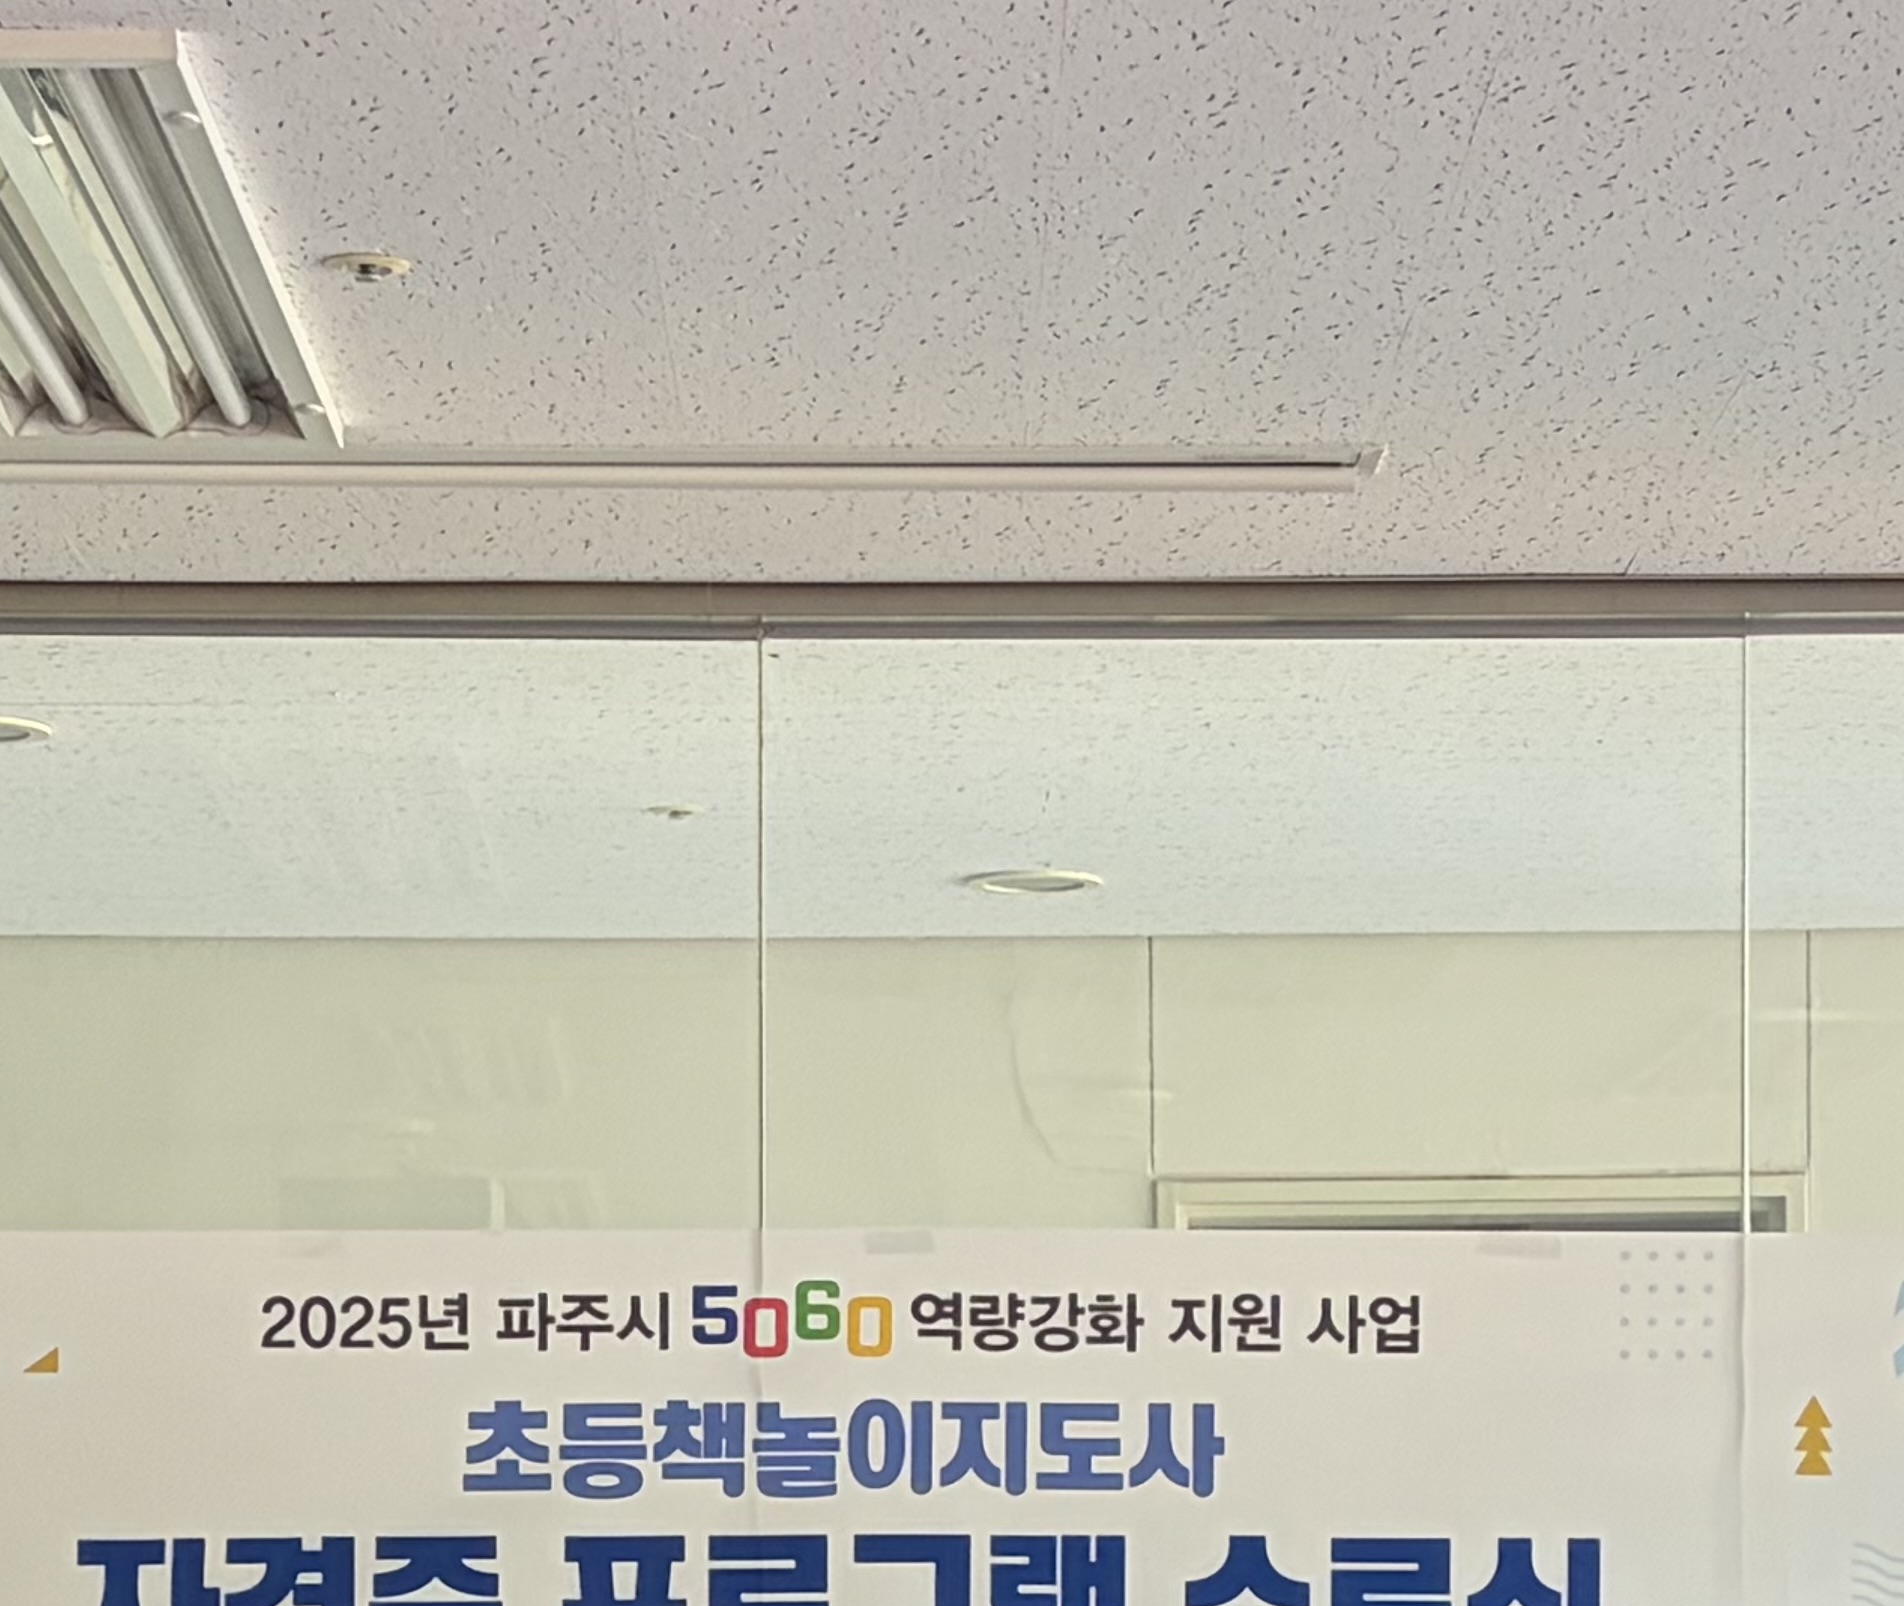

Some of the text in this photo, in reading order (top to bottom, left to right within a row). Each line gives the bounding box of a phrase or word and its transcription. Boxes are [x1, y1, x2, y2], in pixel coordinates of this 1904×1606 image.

[261, 1280, 1421, 1359] 2025년 파주시 5060 역량강화 지원 사업
[460, 1394, 1227, 1503] 초등책놀이지도사
